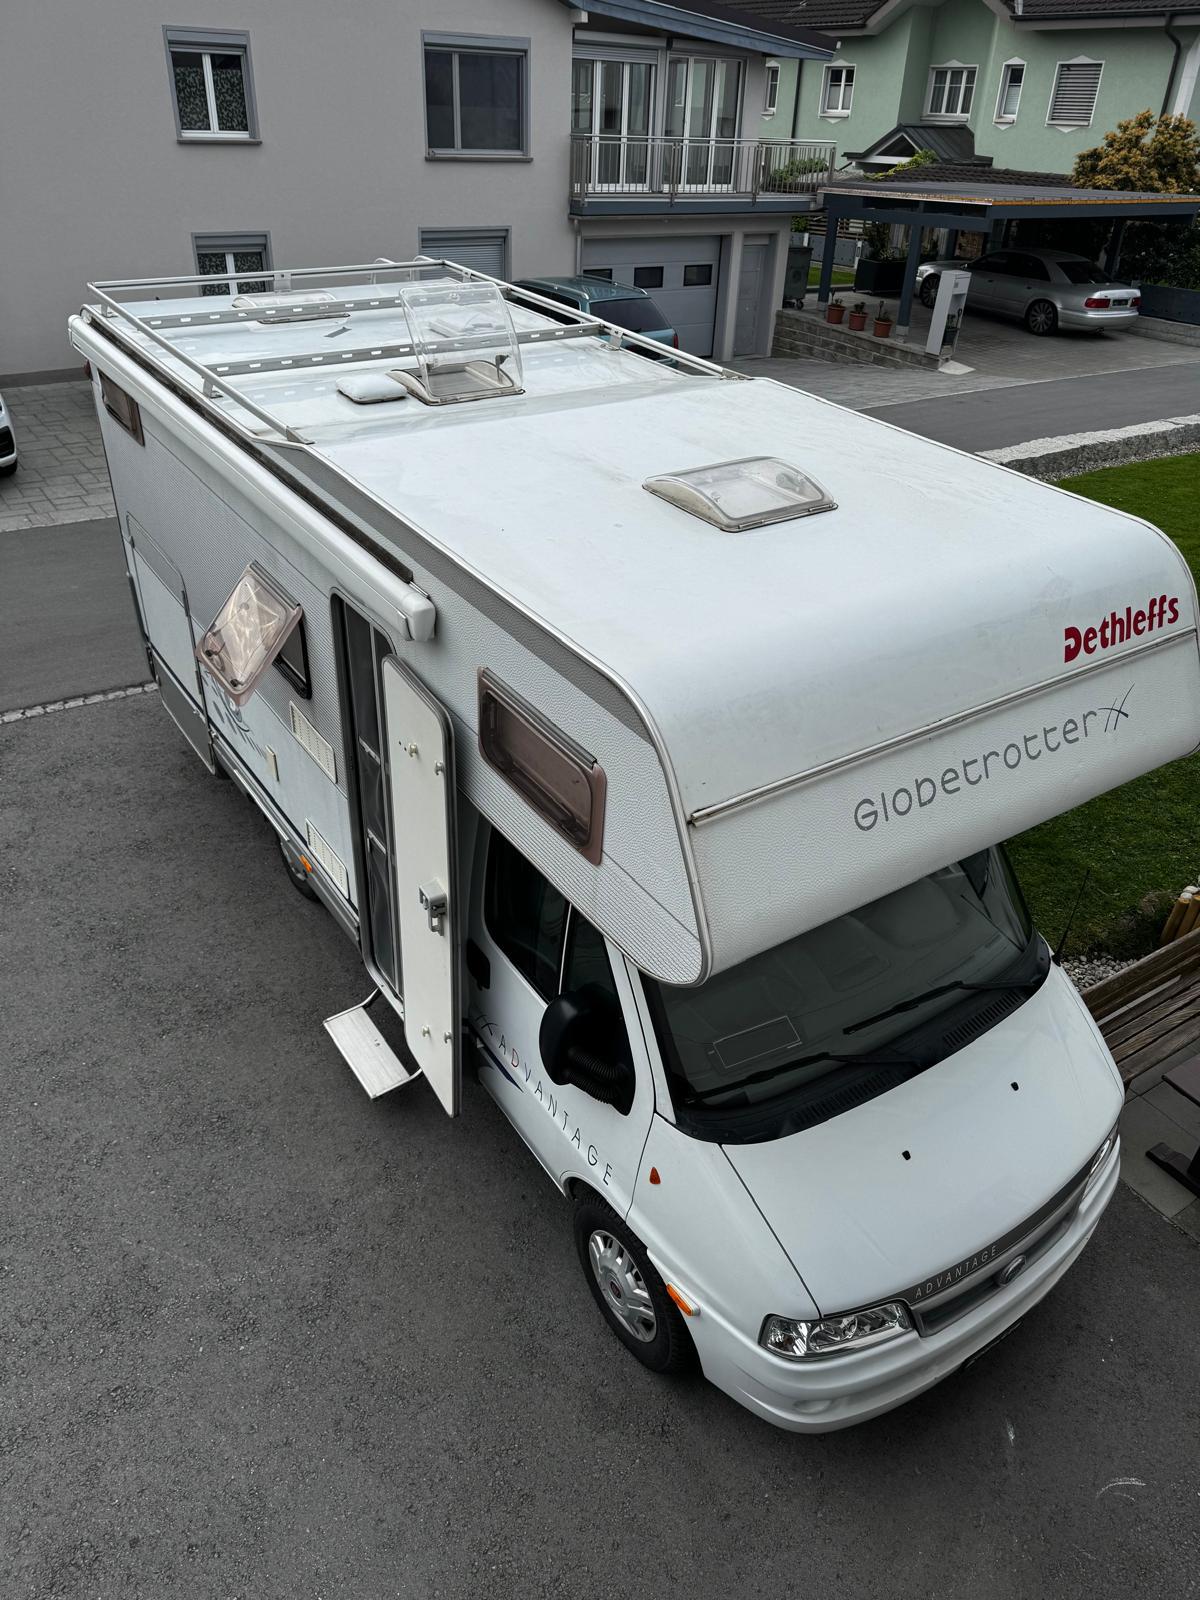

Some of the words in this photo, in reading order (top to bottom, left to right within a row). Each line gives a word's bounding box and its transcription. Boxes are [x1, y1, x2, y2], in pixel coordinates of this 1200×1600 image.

[1064, 594, 1179, 663] Dethleffs
[853, 709, 1097, 832] Globetrotter
[499, 1035, 613, 1186] ADVANTAGE
[915, 1245, 997, 1298] ADVANTAGE
